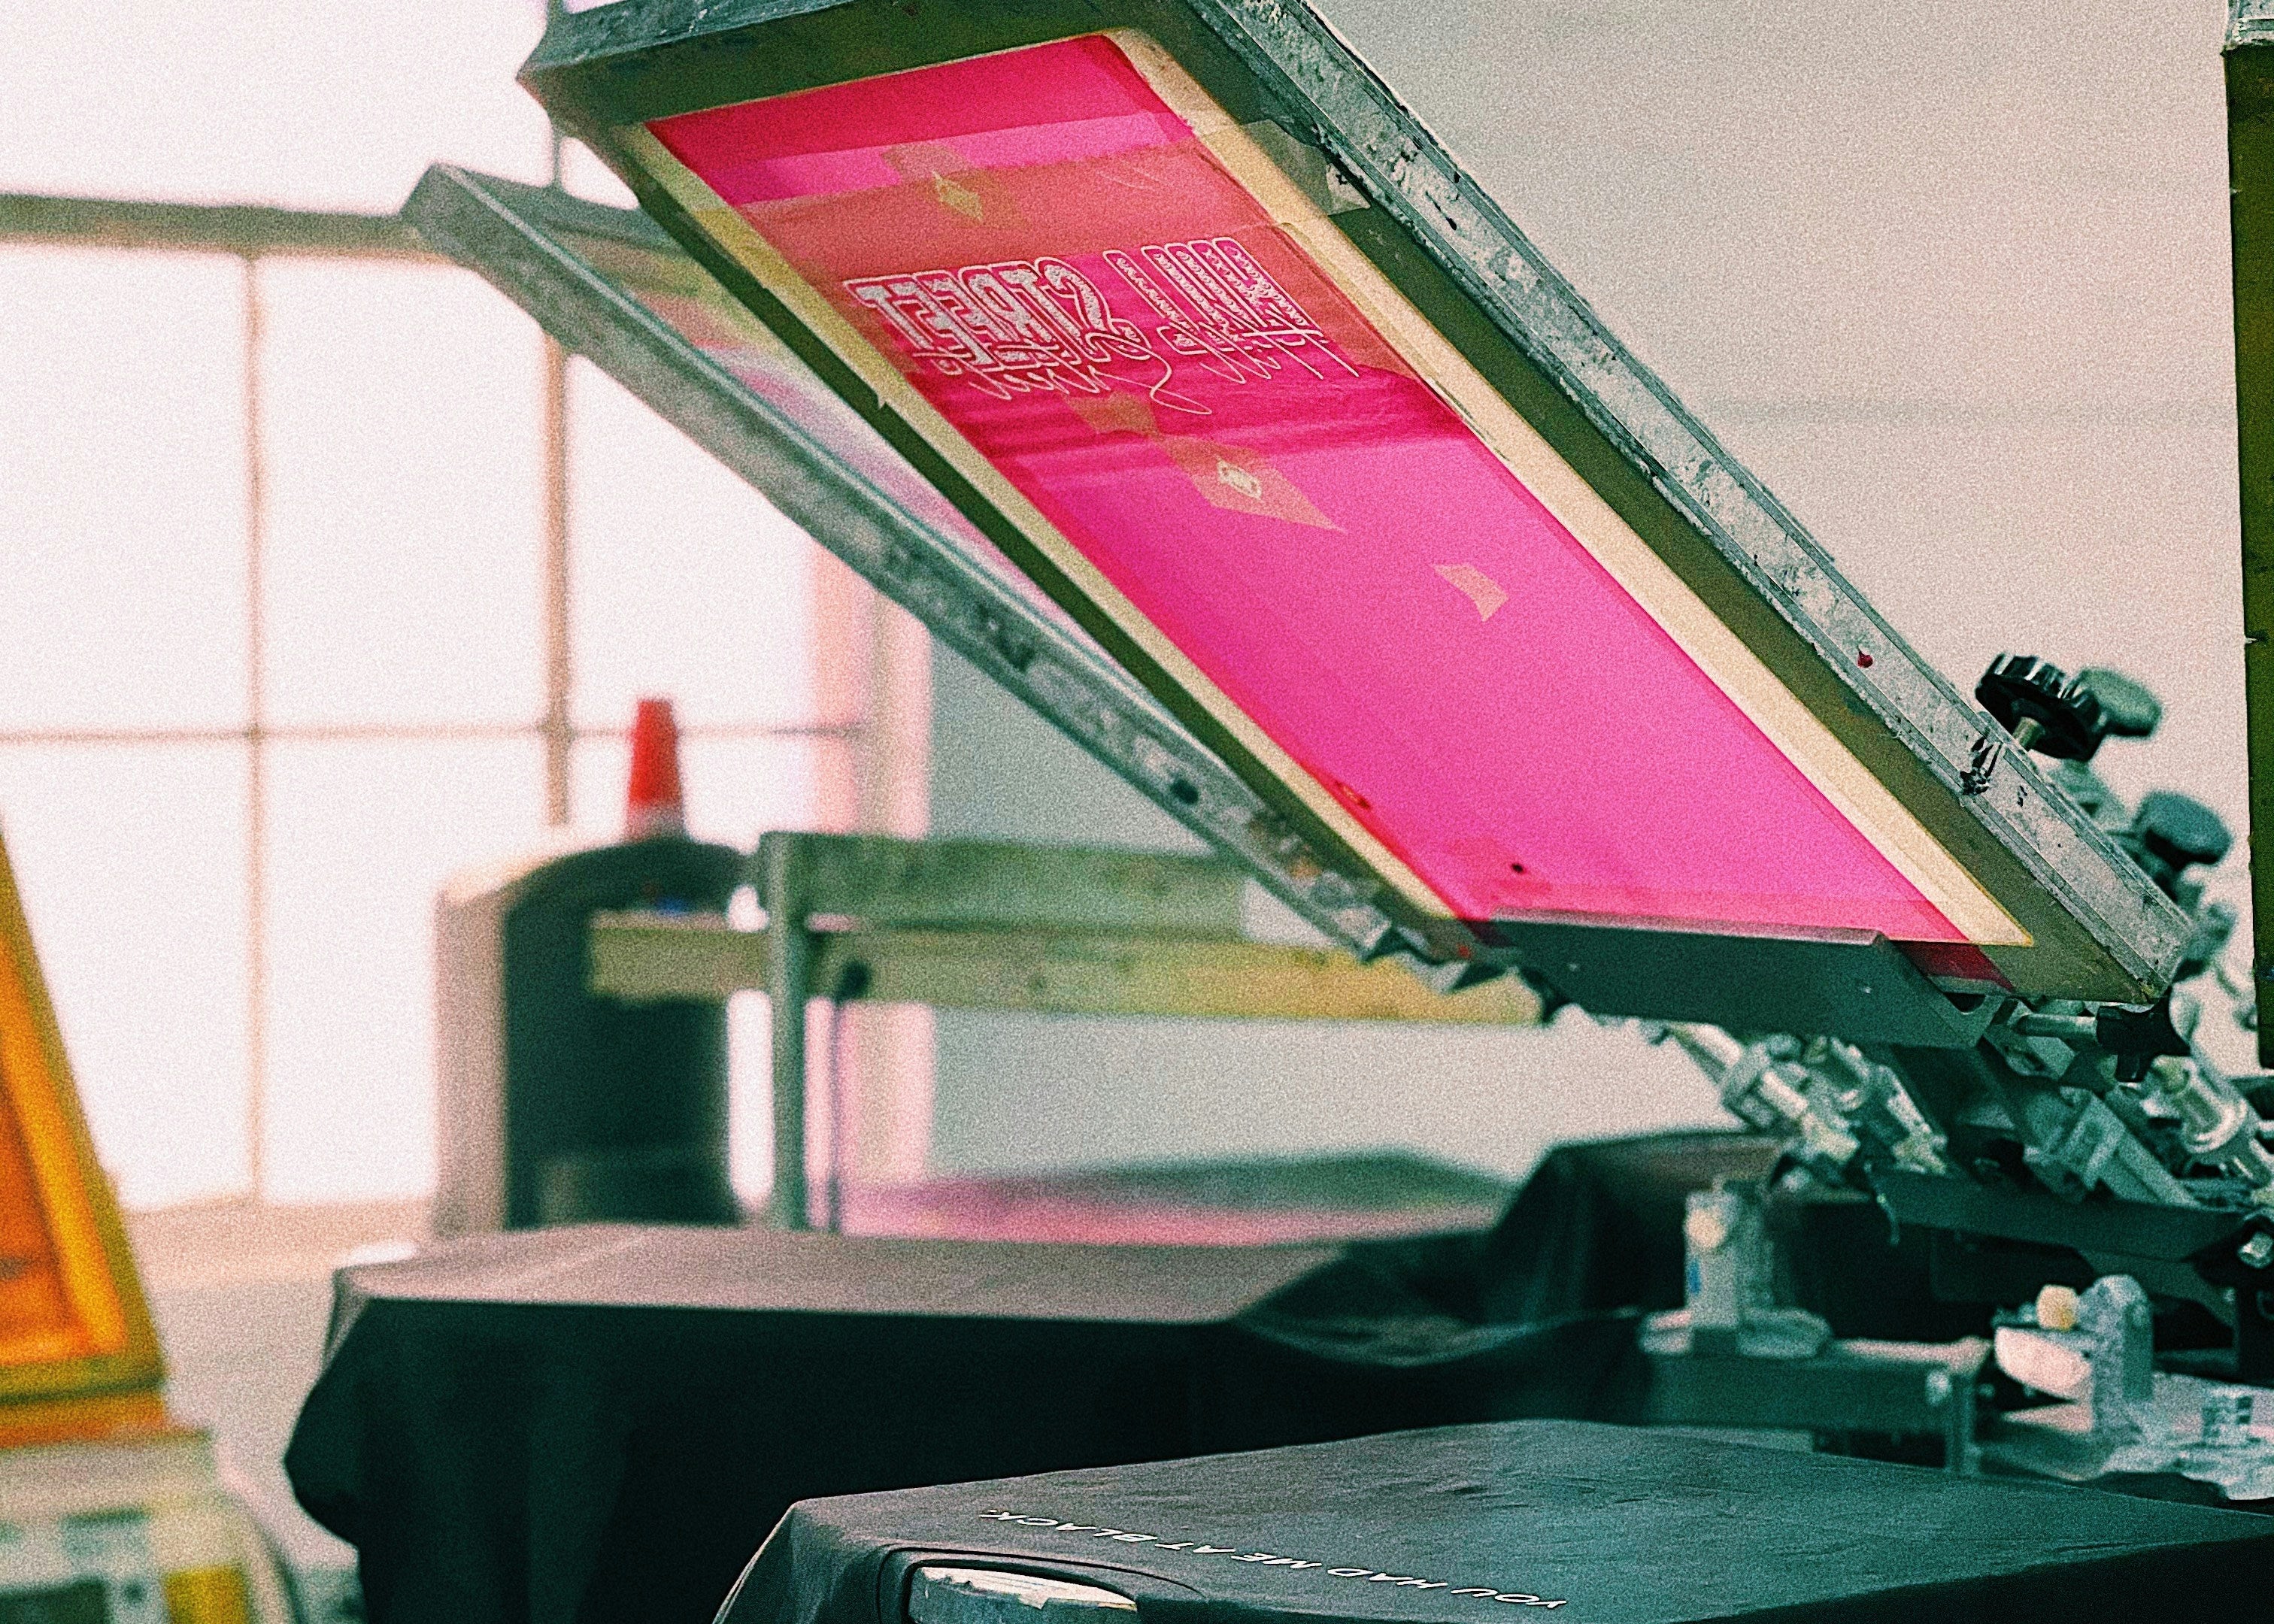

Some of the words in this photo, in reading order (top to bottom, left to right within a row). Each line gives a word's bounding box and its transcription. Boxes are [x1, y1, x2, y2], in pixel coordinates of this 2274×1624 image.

[1155, 1542, 1236, 1553] AT
[1231, 1552, 1323, 1569] ME
[1327, 1568, 1448, 1589] HAD
[1451, 1588, 1567, 1609] YOU
